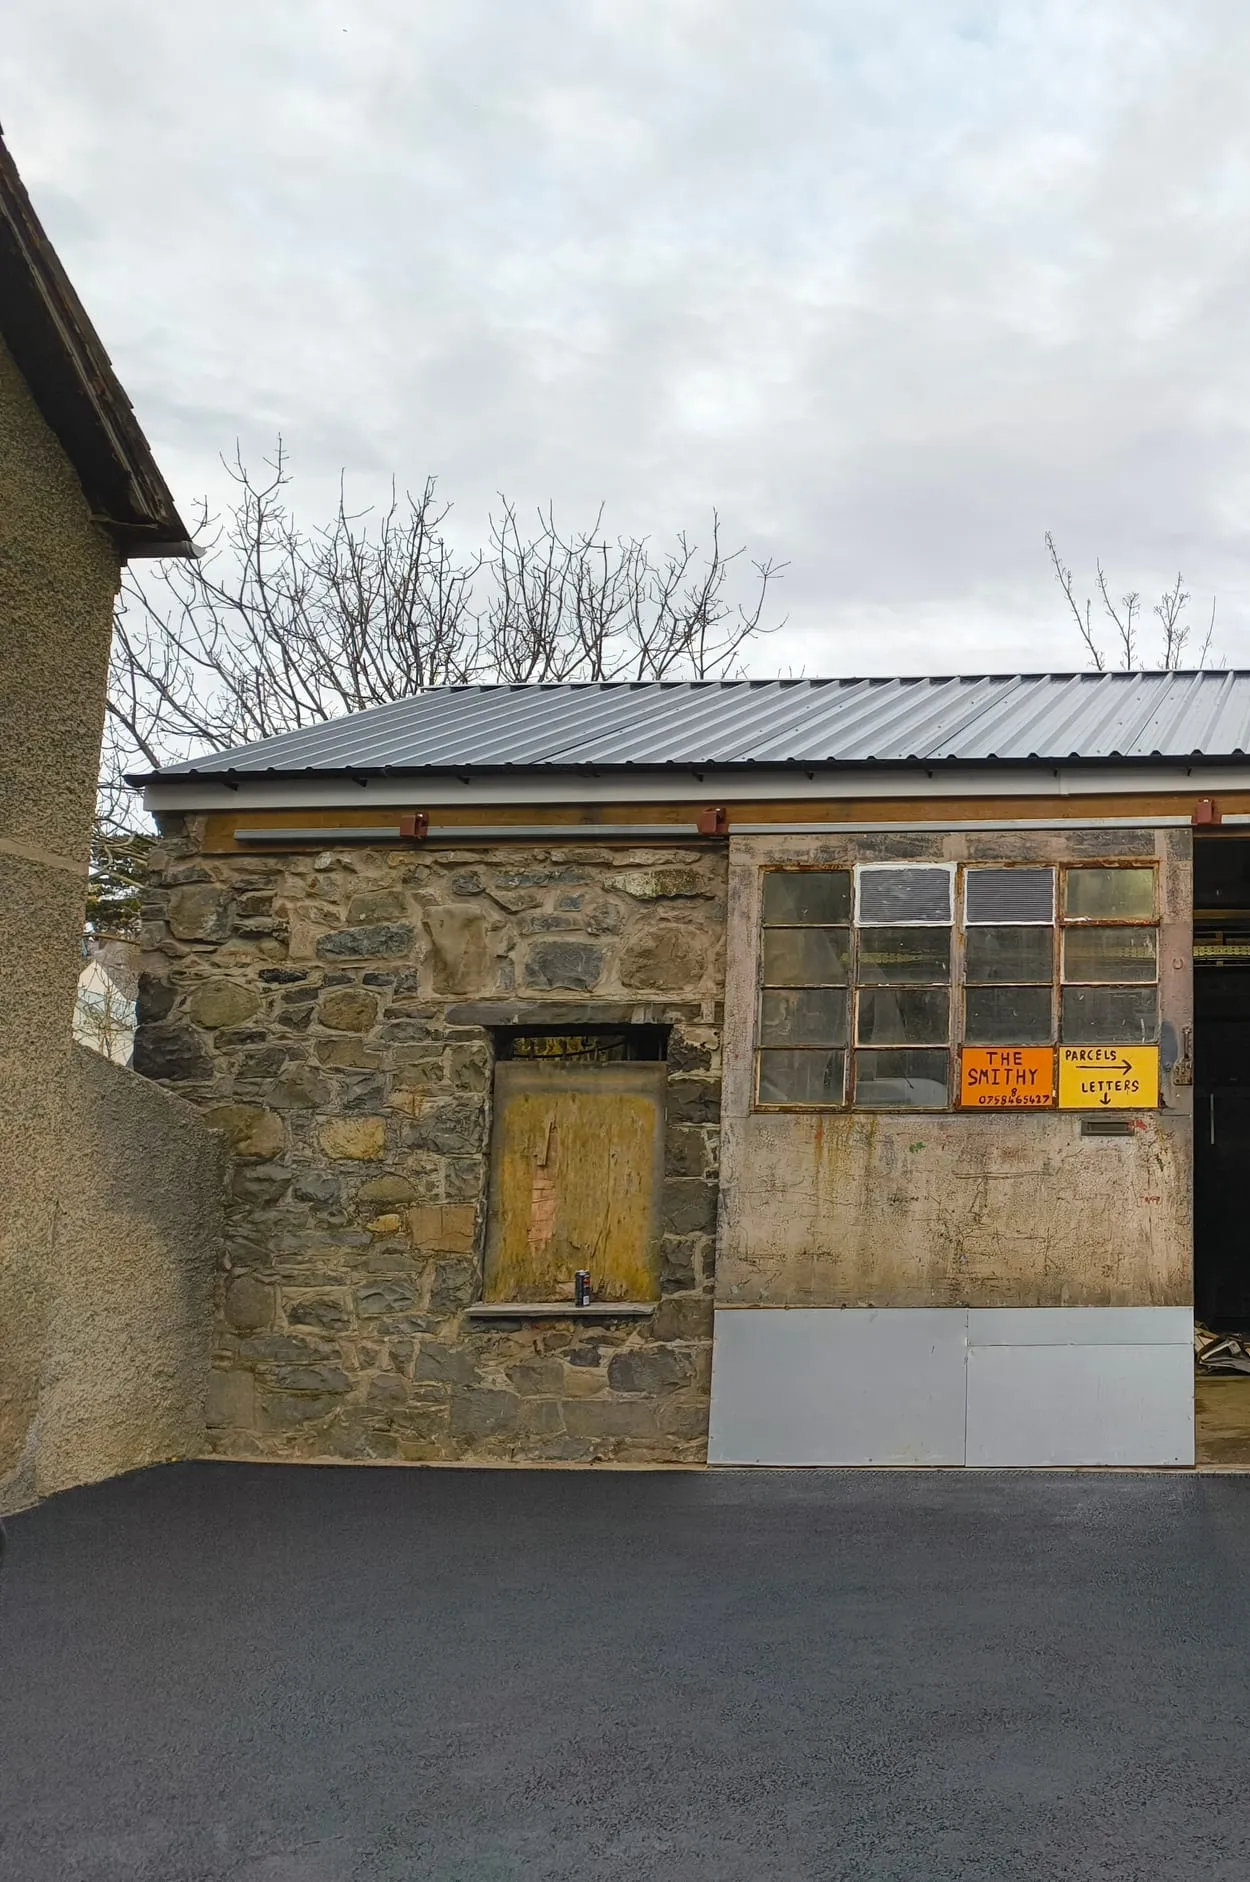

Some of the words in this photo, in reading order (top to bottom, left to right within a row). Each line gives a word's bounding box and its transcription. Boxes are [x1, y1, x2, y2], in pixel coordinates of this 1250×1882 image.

[986, 1051, 1022, 1066] THE
[1065, 1049, 1117, 1061] PARCELS
[968, 1068, 1038, 1086] SMITHY
[1081, 1080, 1139, 1093] LETTERS
